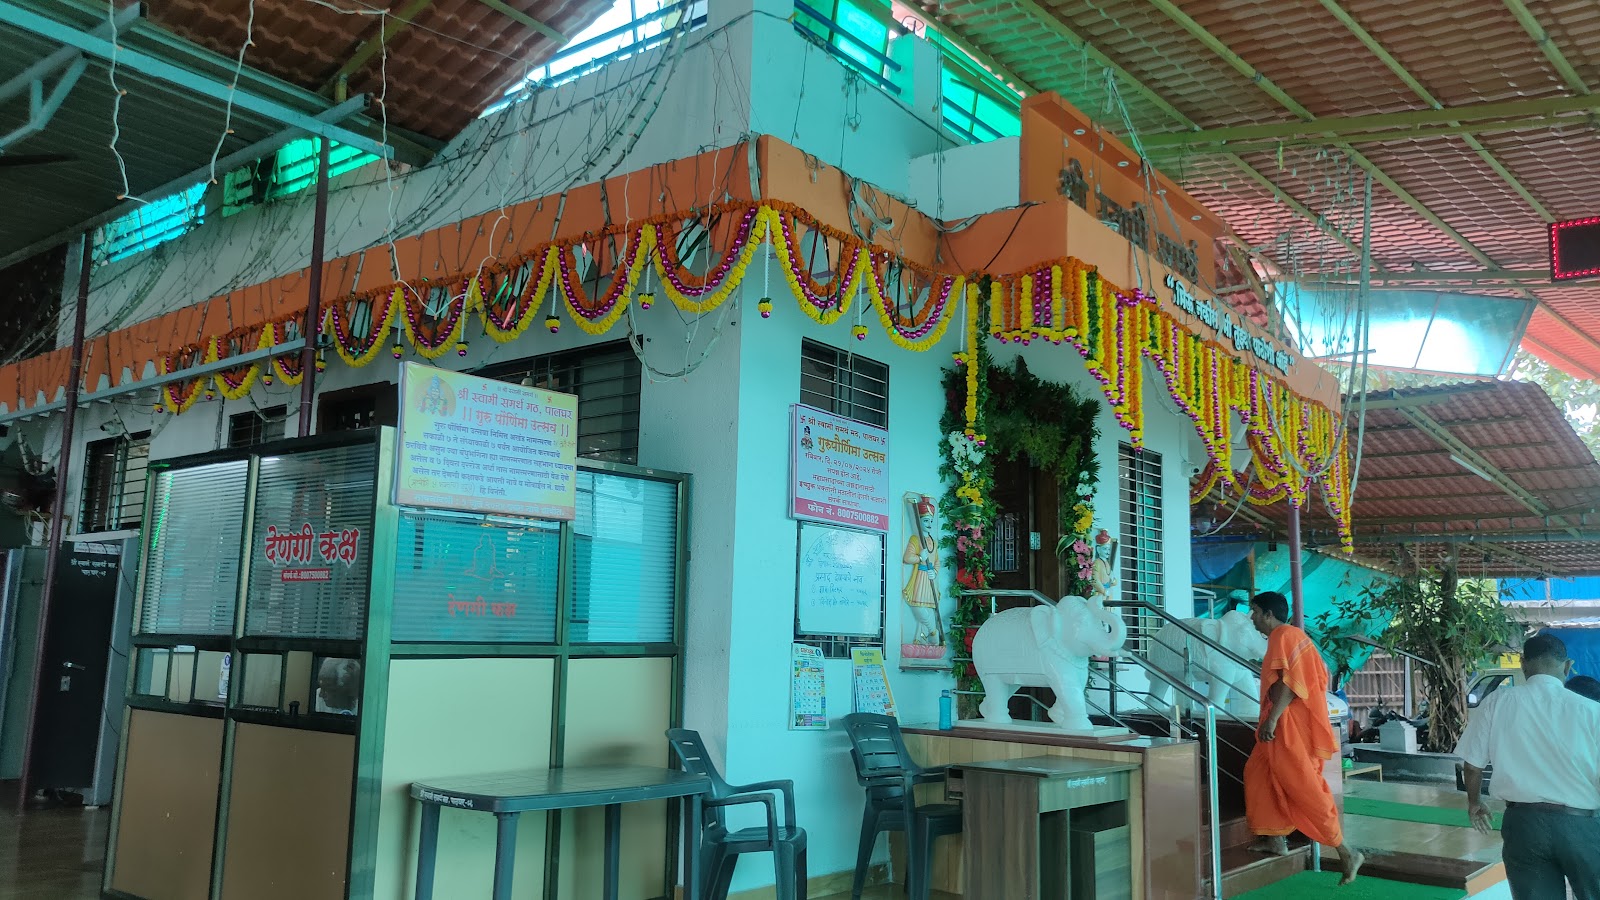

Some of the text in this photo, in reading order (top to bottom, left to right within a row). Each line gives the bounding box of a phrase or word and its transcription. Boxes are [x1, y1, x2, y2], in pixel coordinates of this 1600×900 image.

[457, 386, 468, 400] श्री
[472, 388, 497, 405] स्वामी
[500, 394, 523, 410] समर्थ
[545, 405, 572, 418] पालघर
[476, 409, 491, 426] गुरु
[495, 409, 527, 429] पौर्णिमा
[530, 419, 556, 434] उत्सव
[817, 418, 833, 430] स्वामी
[835, 423, 848, 435] समर्थ
[423, 431, 444, 441] सकाळी
[459, 436, 489, 447] संध्याकाळी
[512, 444, 536, 454] आयोजित
[817, 429, 885, 465] गुरुपौर्णिमा उत्सव
[410, 453, 428, 462] असेल
[412, 465, 430, 475] असेल
[442, 469, 459, 479] देणगी
[807, 500, 823, 513] फोन
[837, 507, 878, 524] 8007500882
[265, 522, 360, 568] देणगी कक्ष
[448, 594, 517, 618] देणगी कक्ष
